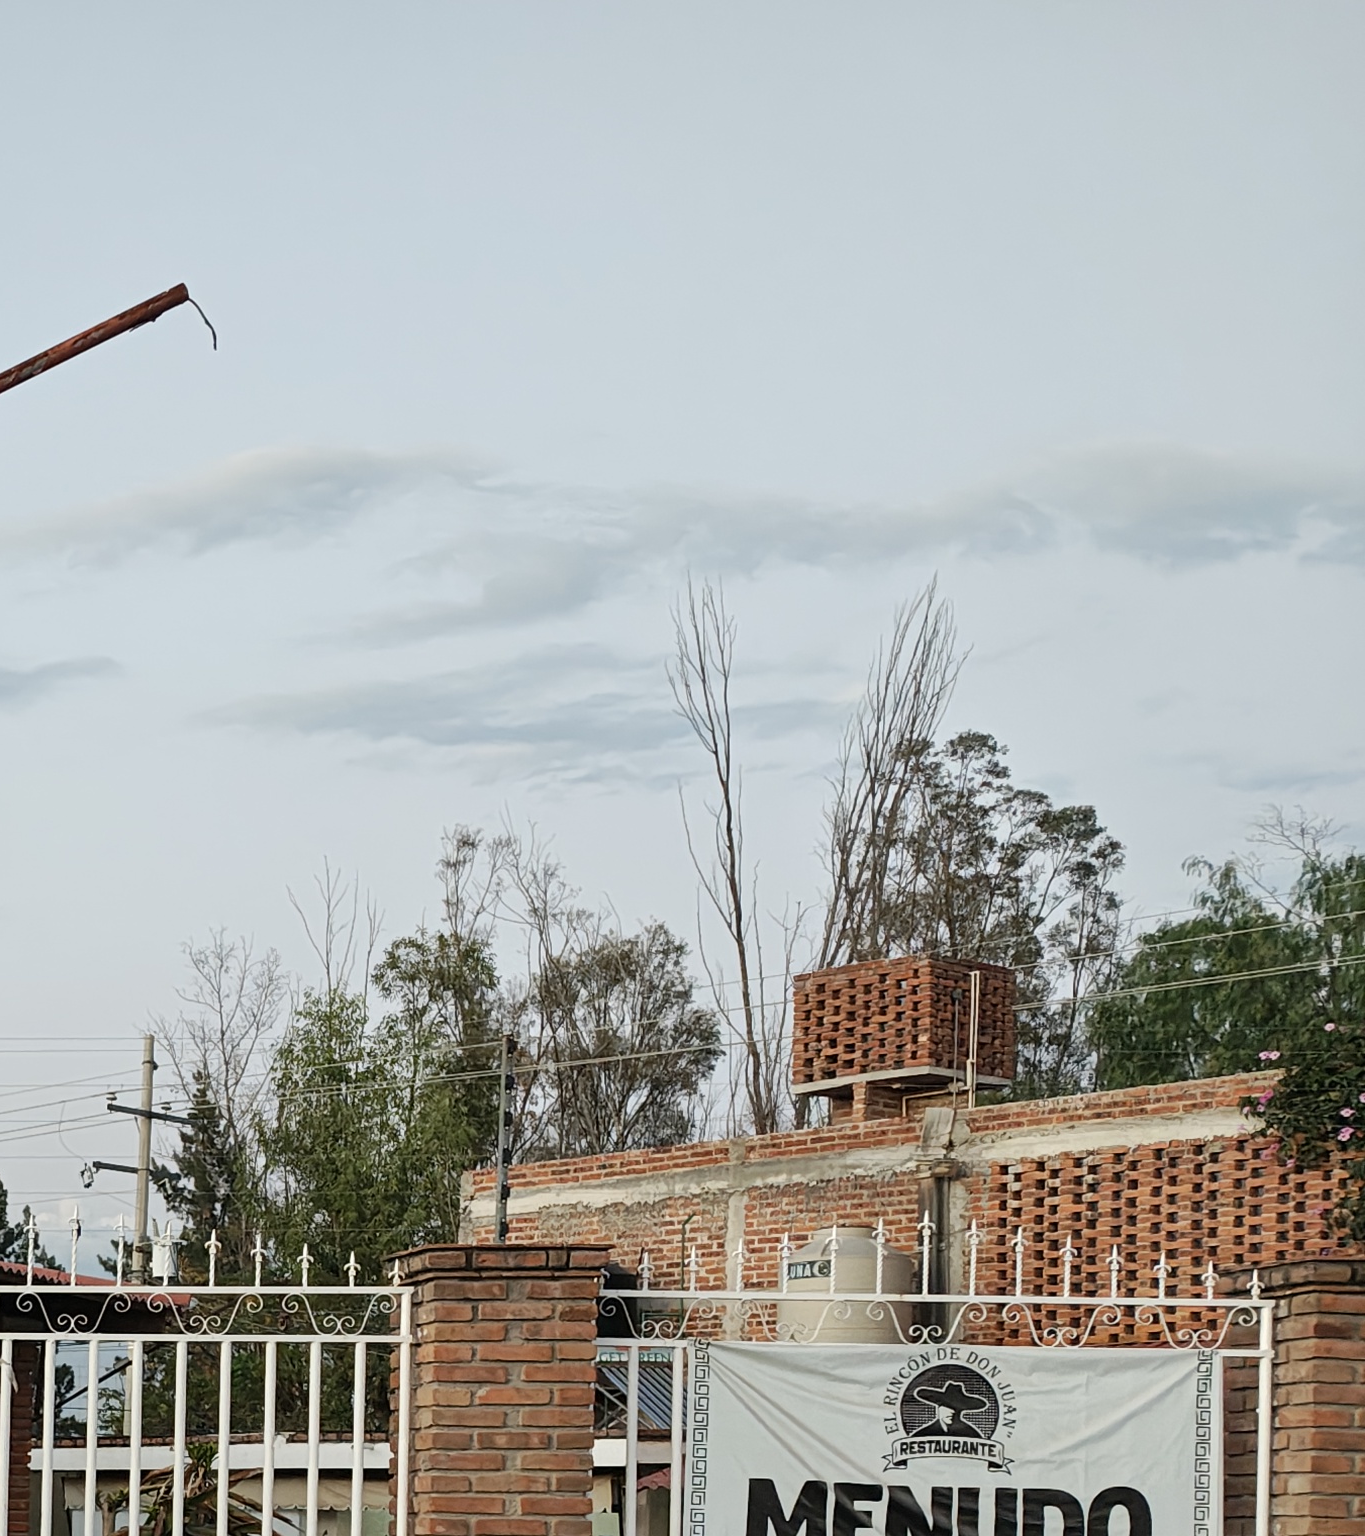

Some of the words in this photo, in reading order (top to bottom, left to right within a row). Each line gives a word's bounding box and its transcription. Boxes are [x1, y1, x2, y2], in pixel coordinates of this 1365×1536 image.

[937, 1347, 961, 1362] DE
[965, 1351, 1002, 1379] DON
[883, 1351, 932, 1407] RINCÓN
[882, 1412, 900, 1435] EL
[899, 1440, 997, 1458] RESTAURANTE
